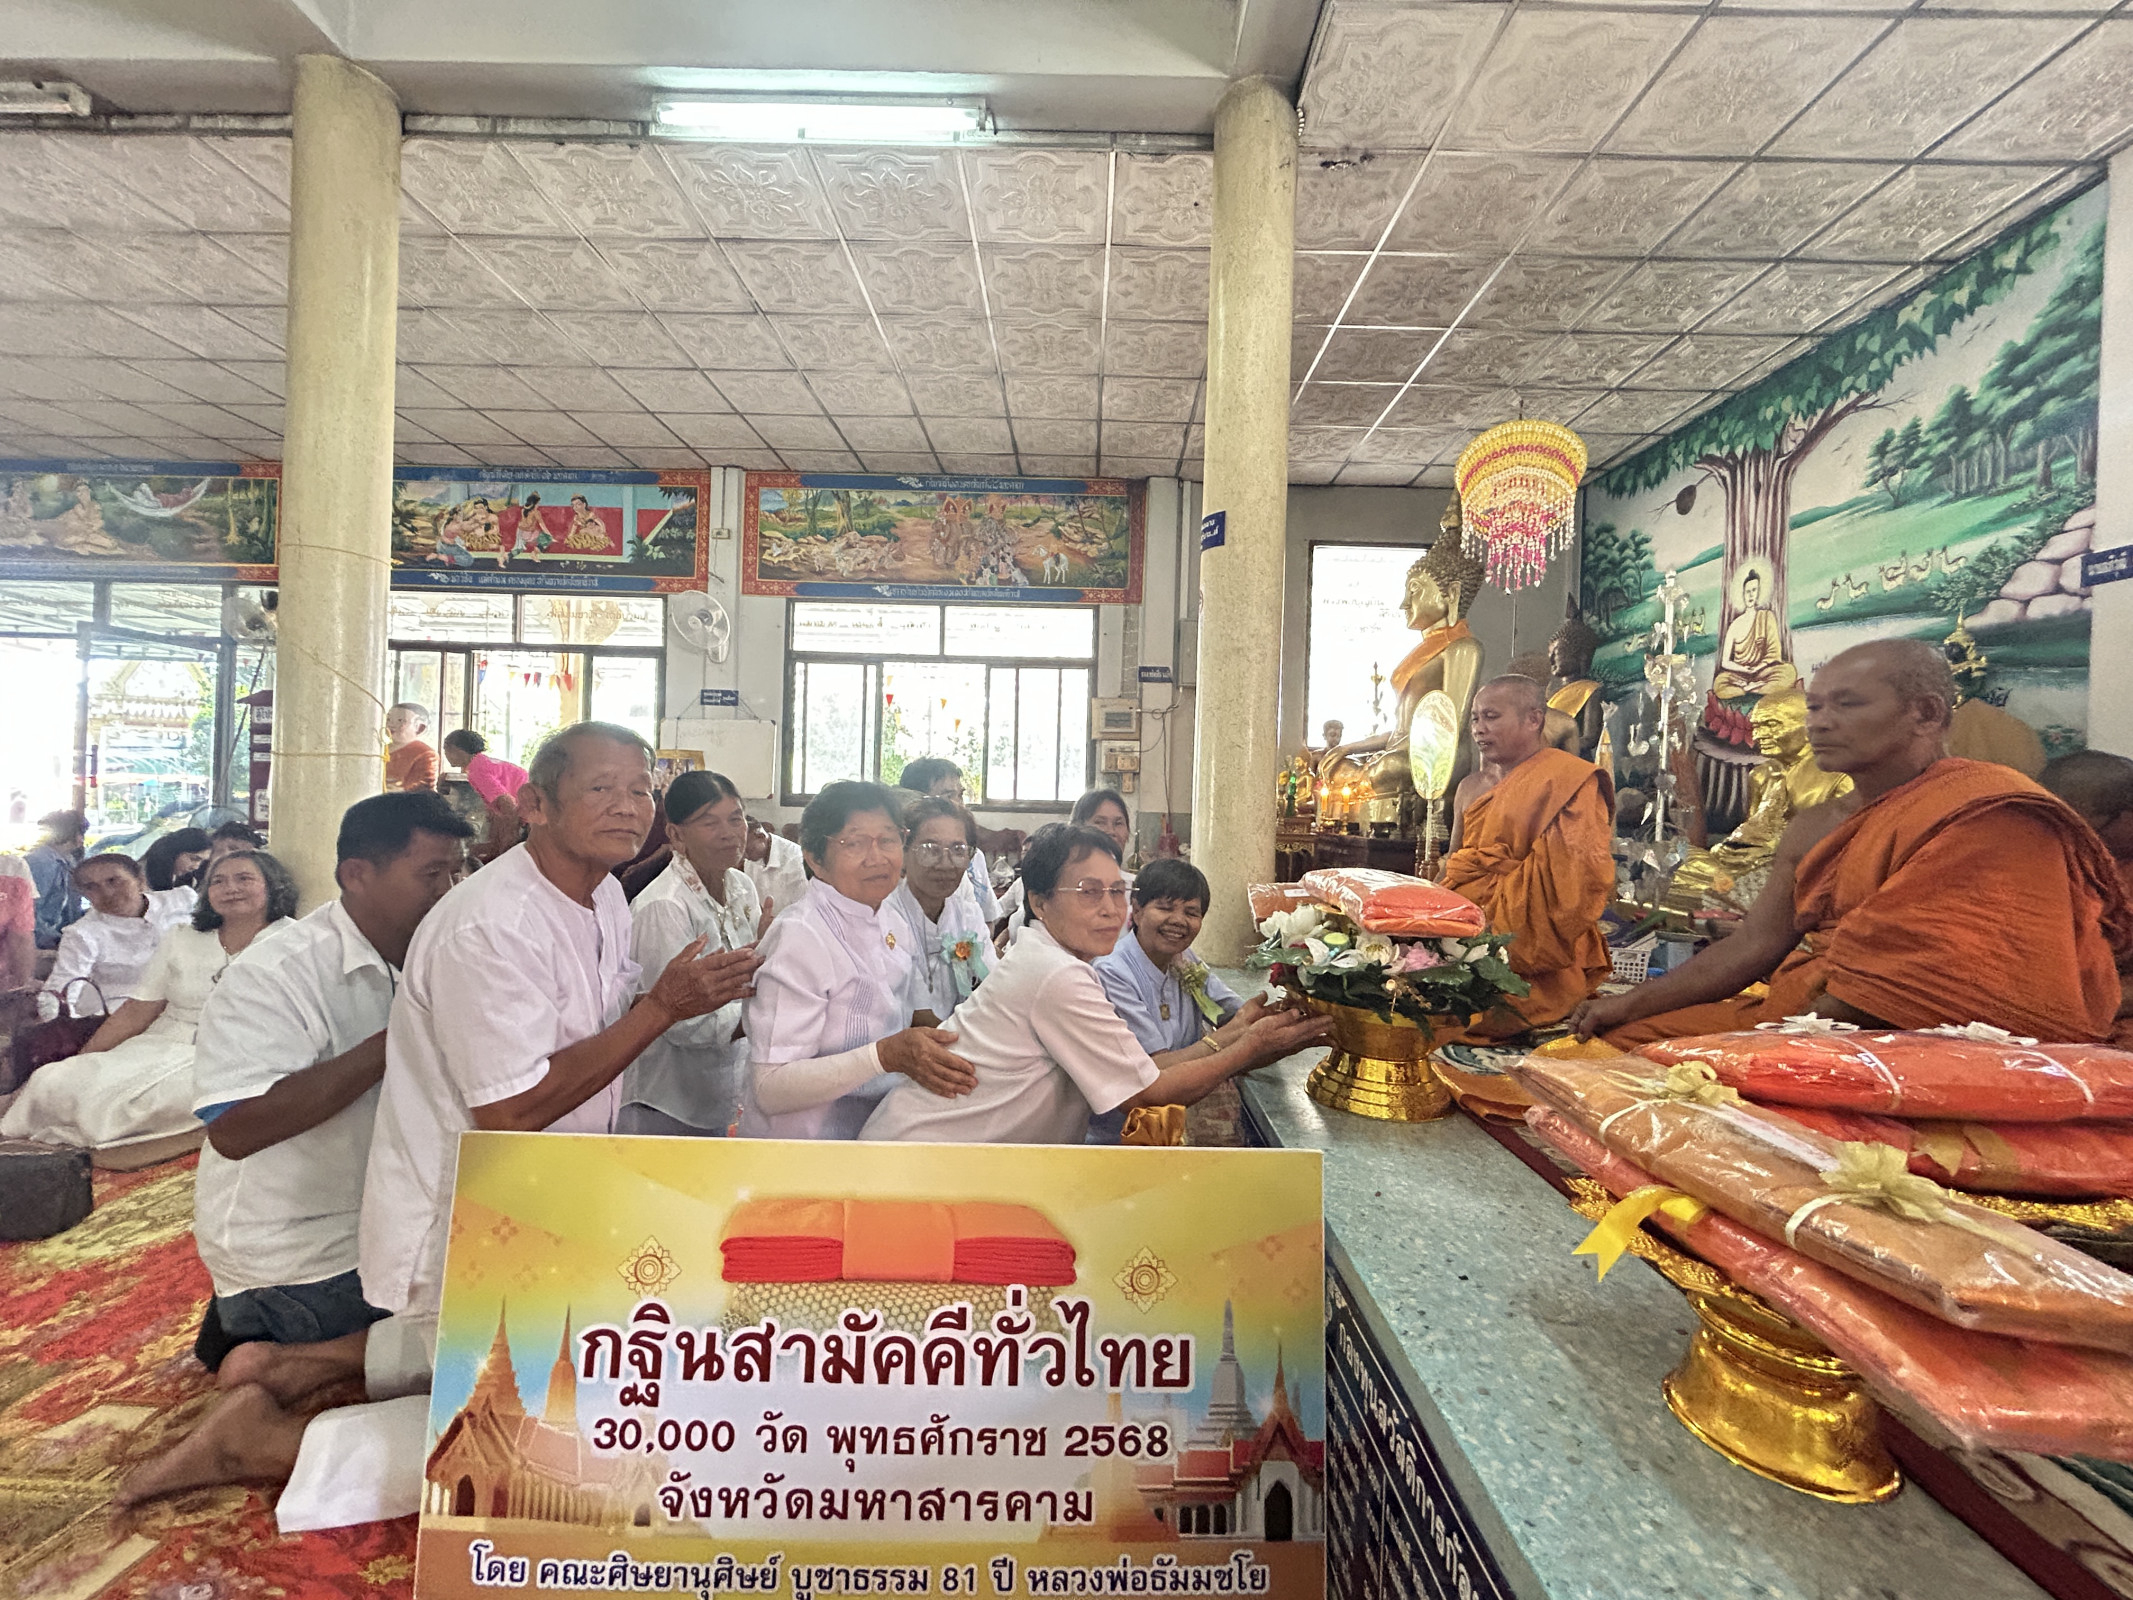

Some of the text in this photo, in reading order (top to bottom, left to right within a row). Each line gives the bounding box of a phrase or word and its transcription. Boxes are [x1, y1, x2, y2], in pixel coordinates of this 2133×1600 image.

[583, 1290, 1191, 1407] กฐินสามัคคีทั่วไทย
[592, 1410, 1172, 1473] 30,000 วัด พุทธศักราช 2568
[659, 1472, 1094, 1522] จังหวัดมหาสารคาม
[472, 1542, 1267, 1600] โดย คณะศิษยานุศิษย์ บูชาธรรม 81 ปี หลวงพ่อธัมมชโย
